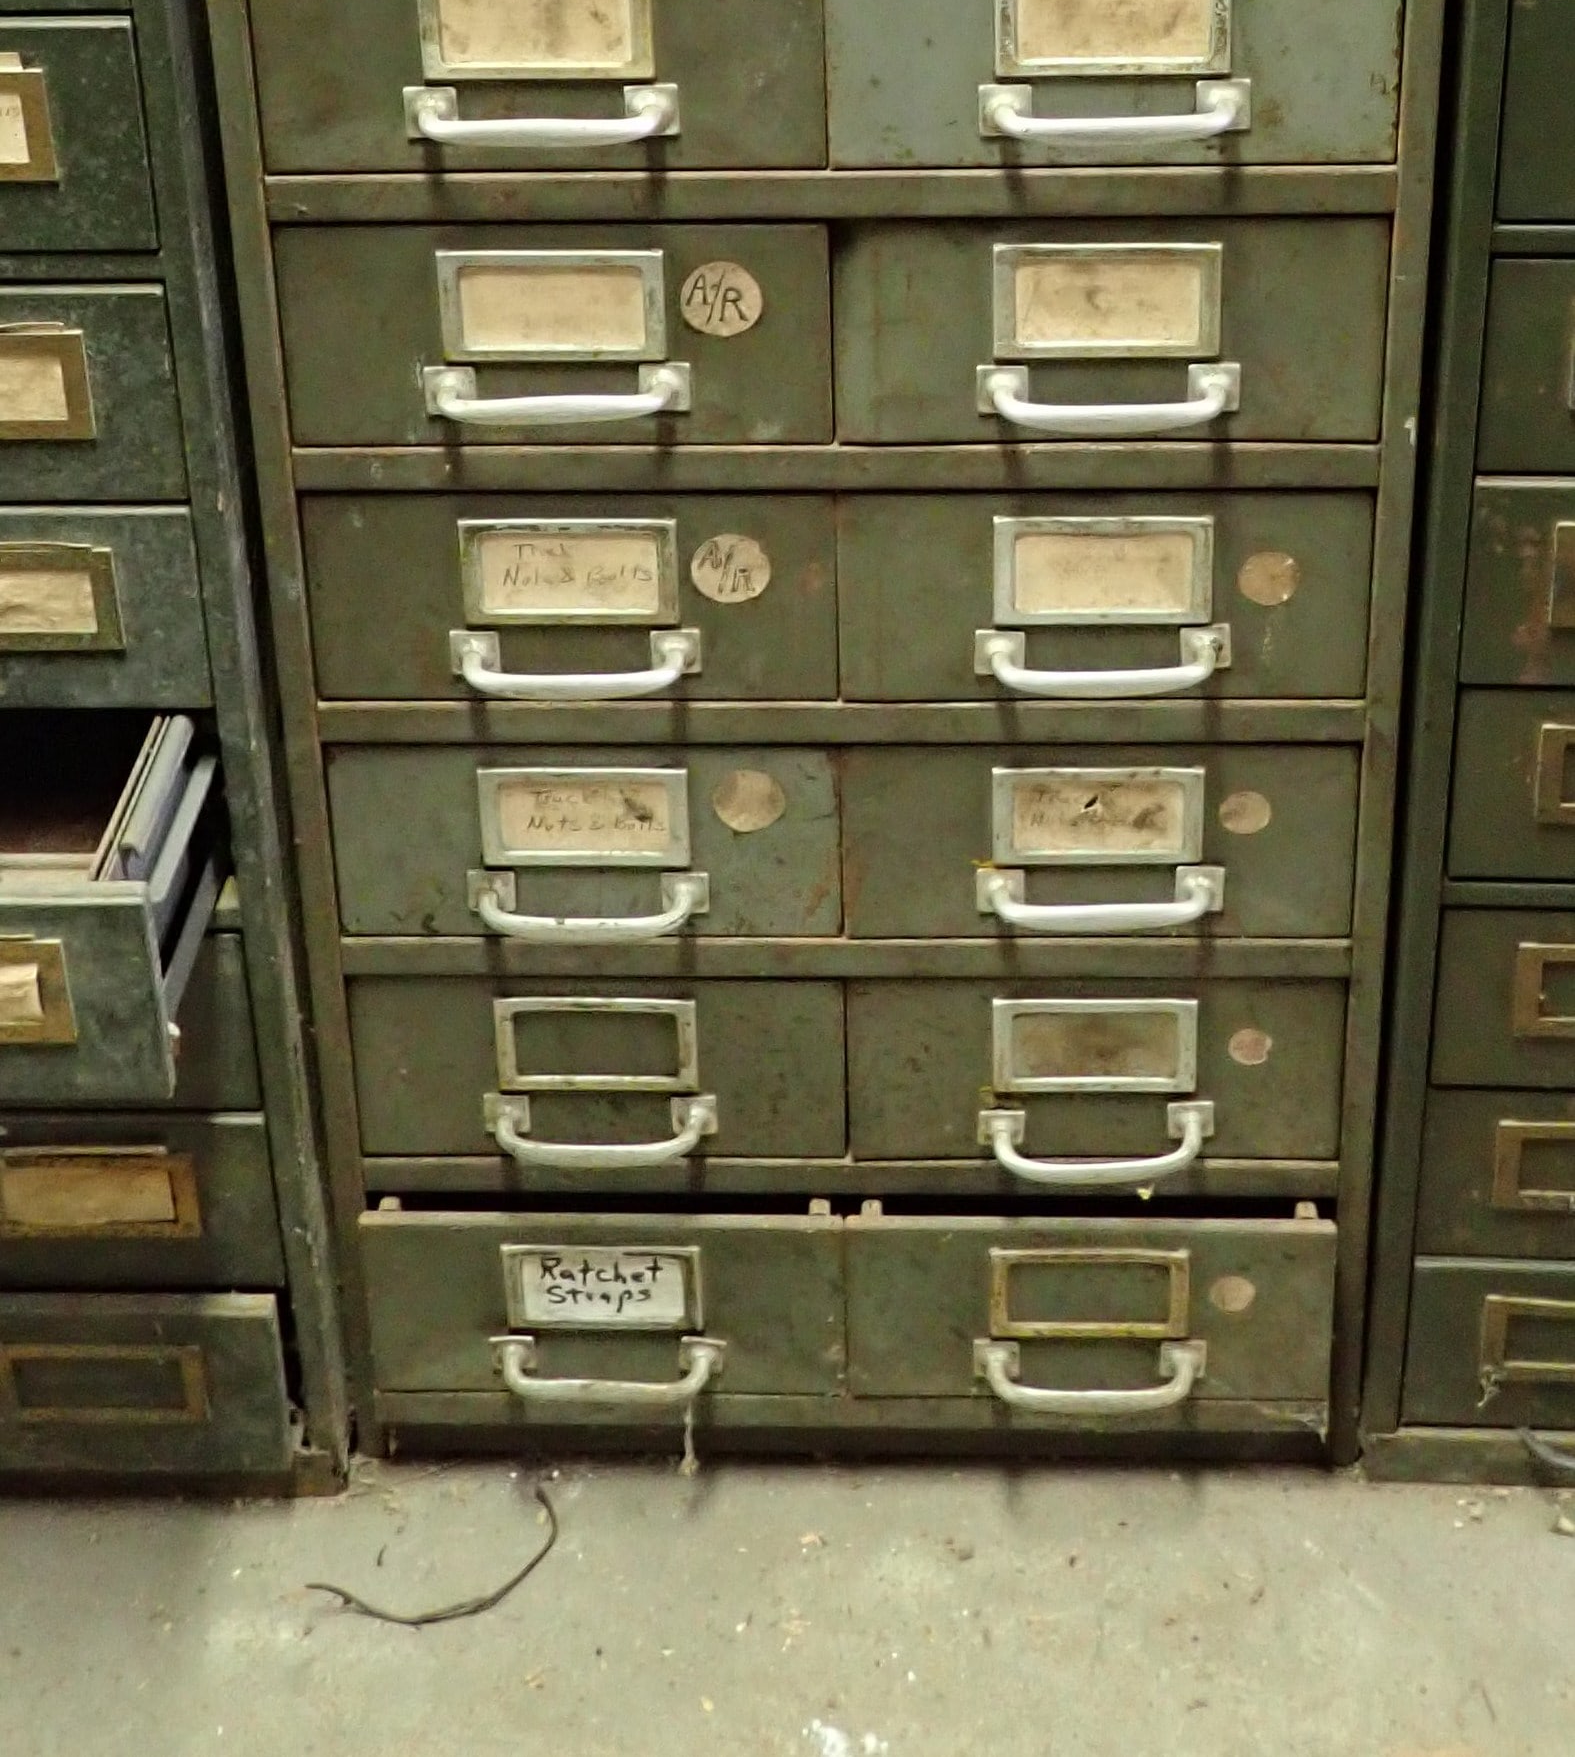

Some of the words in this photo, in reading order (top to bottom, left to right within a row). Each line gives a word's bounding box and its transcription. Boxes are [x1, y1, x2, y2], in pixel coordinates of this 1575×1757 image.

[685, 268, 749, 326] A/R
[540, 1255, 664, 1286] Ratchet
[546, 1284, 652, 1314] Straps
